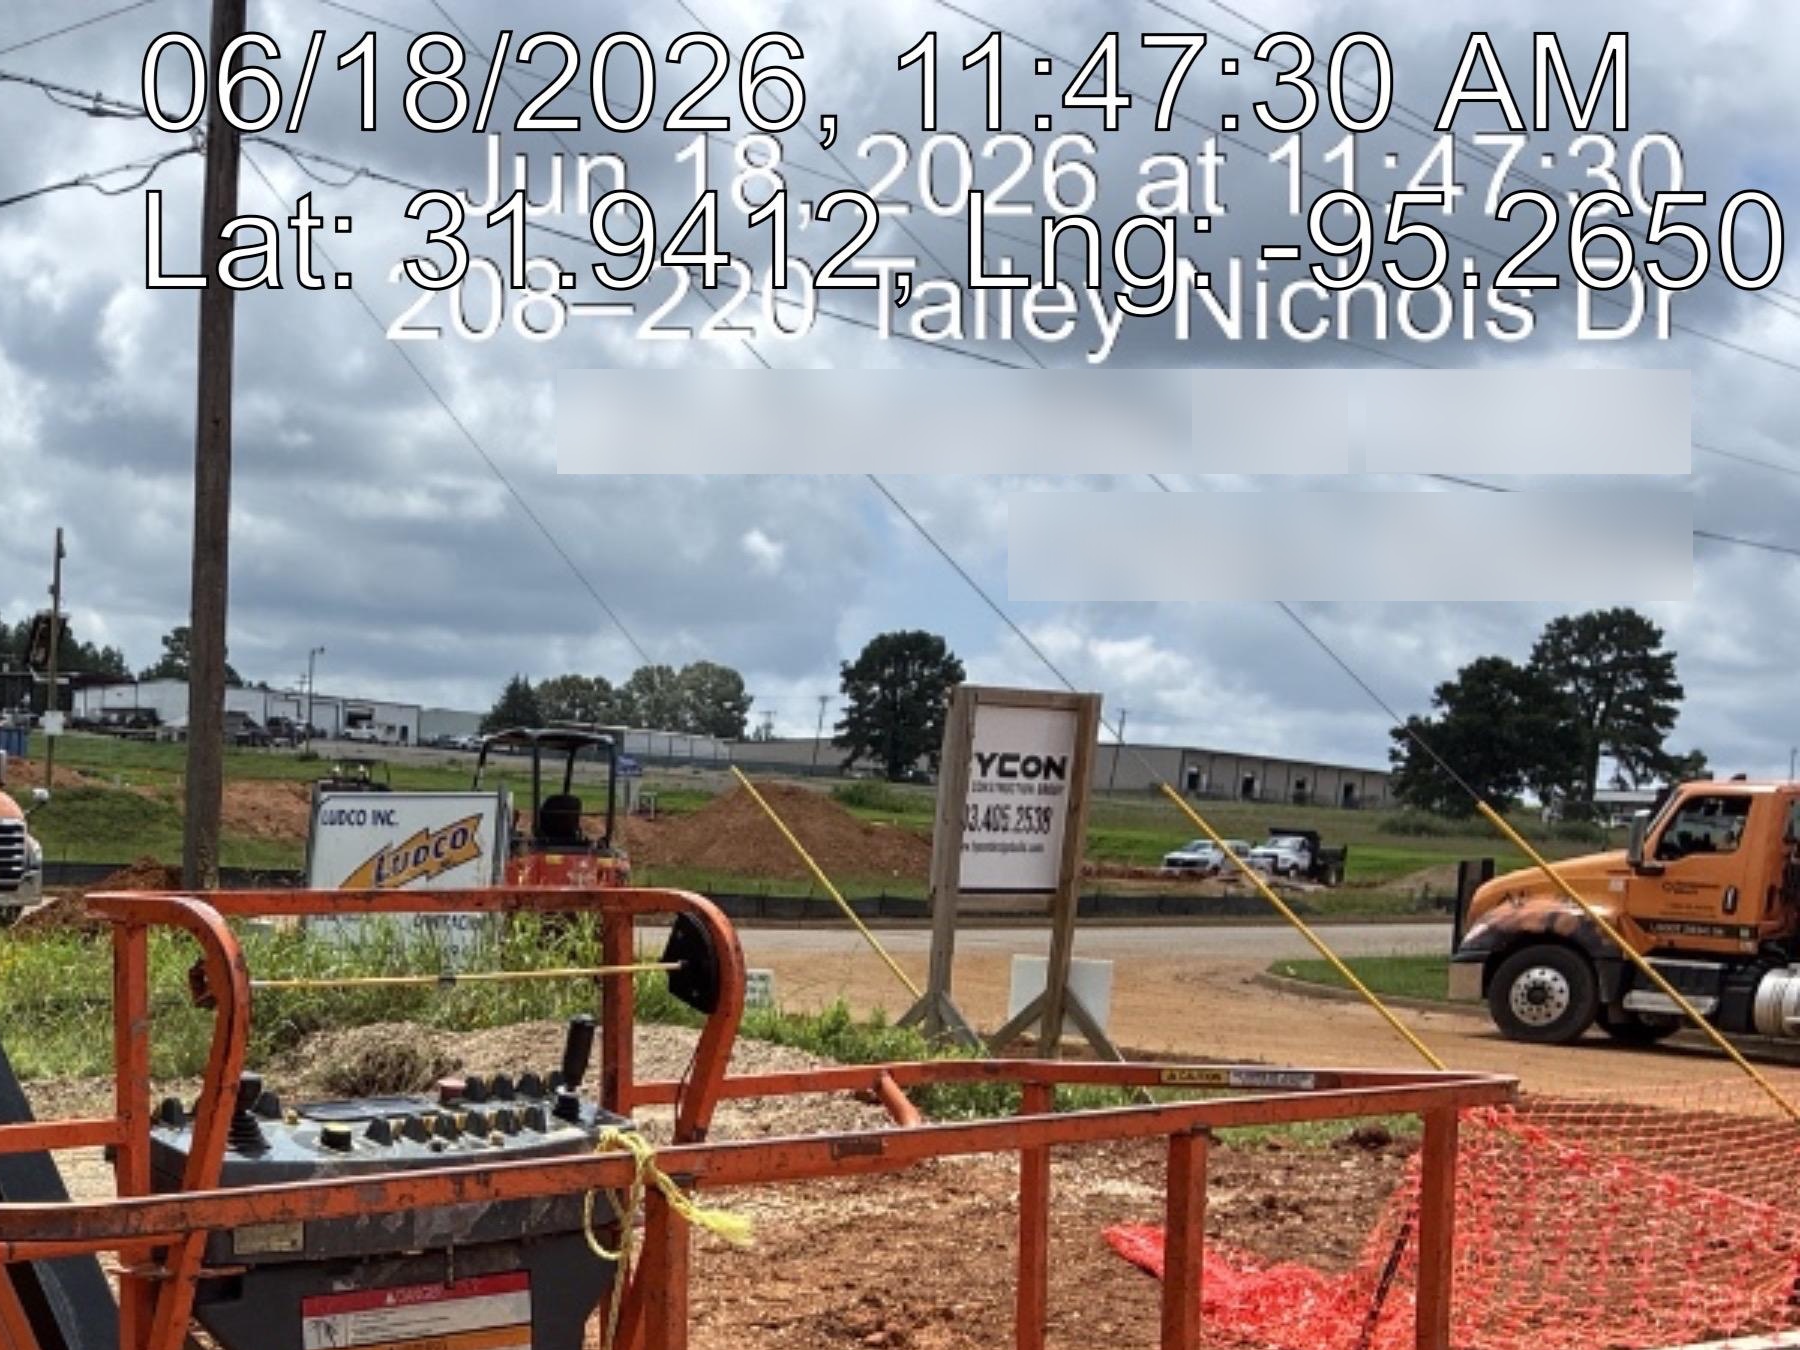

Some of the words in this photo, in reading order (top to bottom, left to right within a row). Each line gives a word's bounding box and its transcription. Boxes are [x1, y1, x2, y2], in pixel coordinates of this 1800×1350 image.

[973, 752, 1068, 780] YCON
[321, 809, 367, 826] LUDCO
[371, 809, 399, 826] INC.
